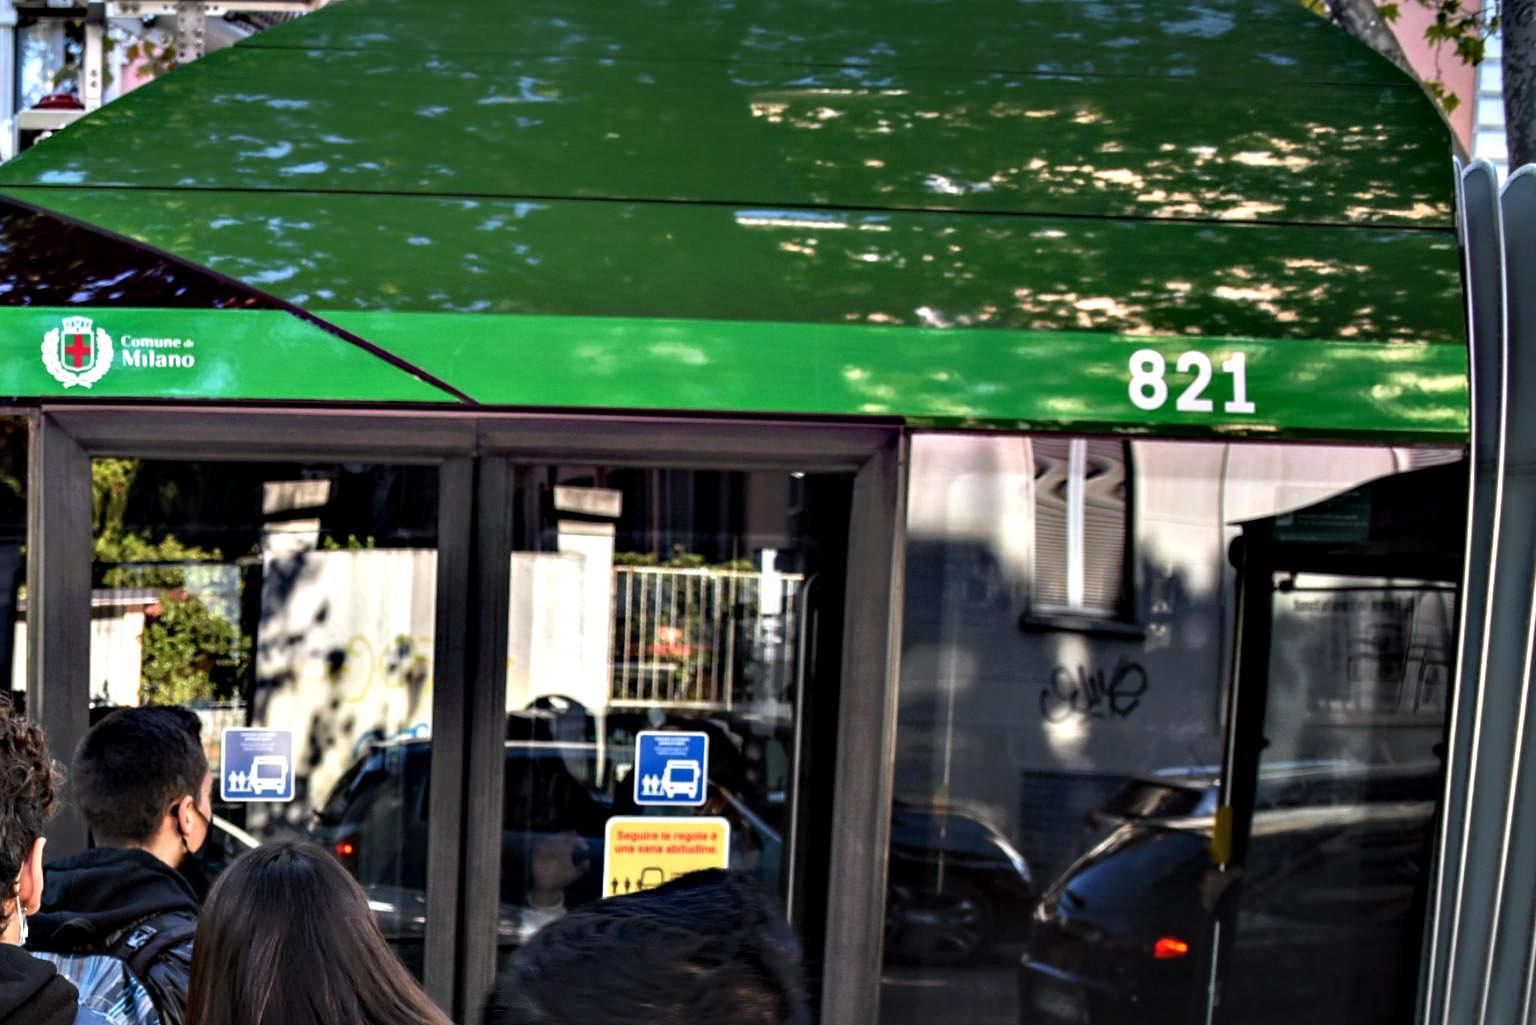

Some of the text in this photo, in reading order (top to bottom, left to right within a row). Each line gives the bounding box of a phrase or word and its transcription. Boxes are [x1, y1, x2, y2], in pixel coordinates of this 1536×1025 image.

[120, 335, 182, 348] Comune
[121, 349, 196, 368] Milano
[1128, 349, 1256, 414] 821
